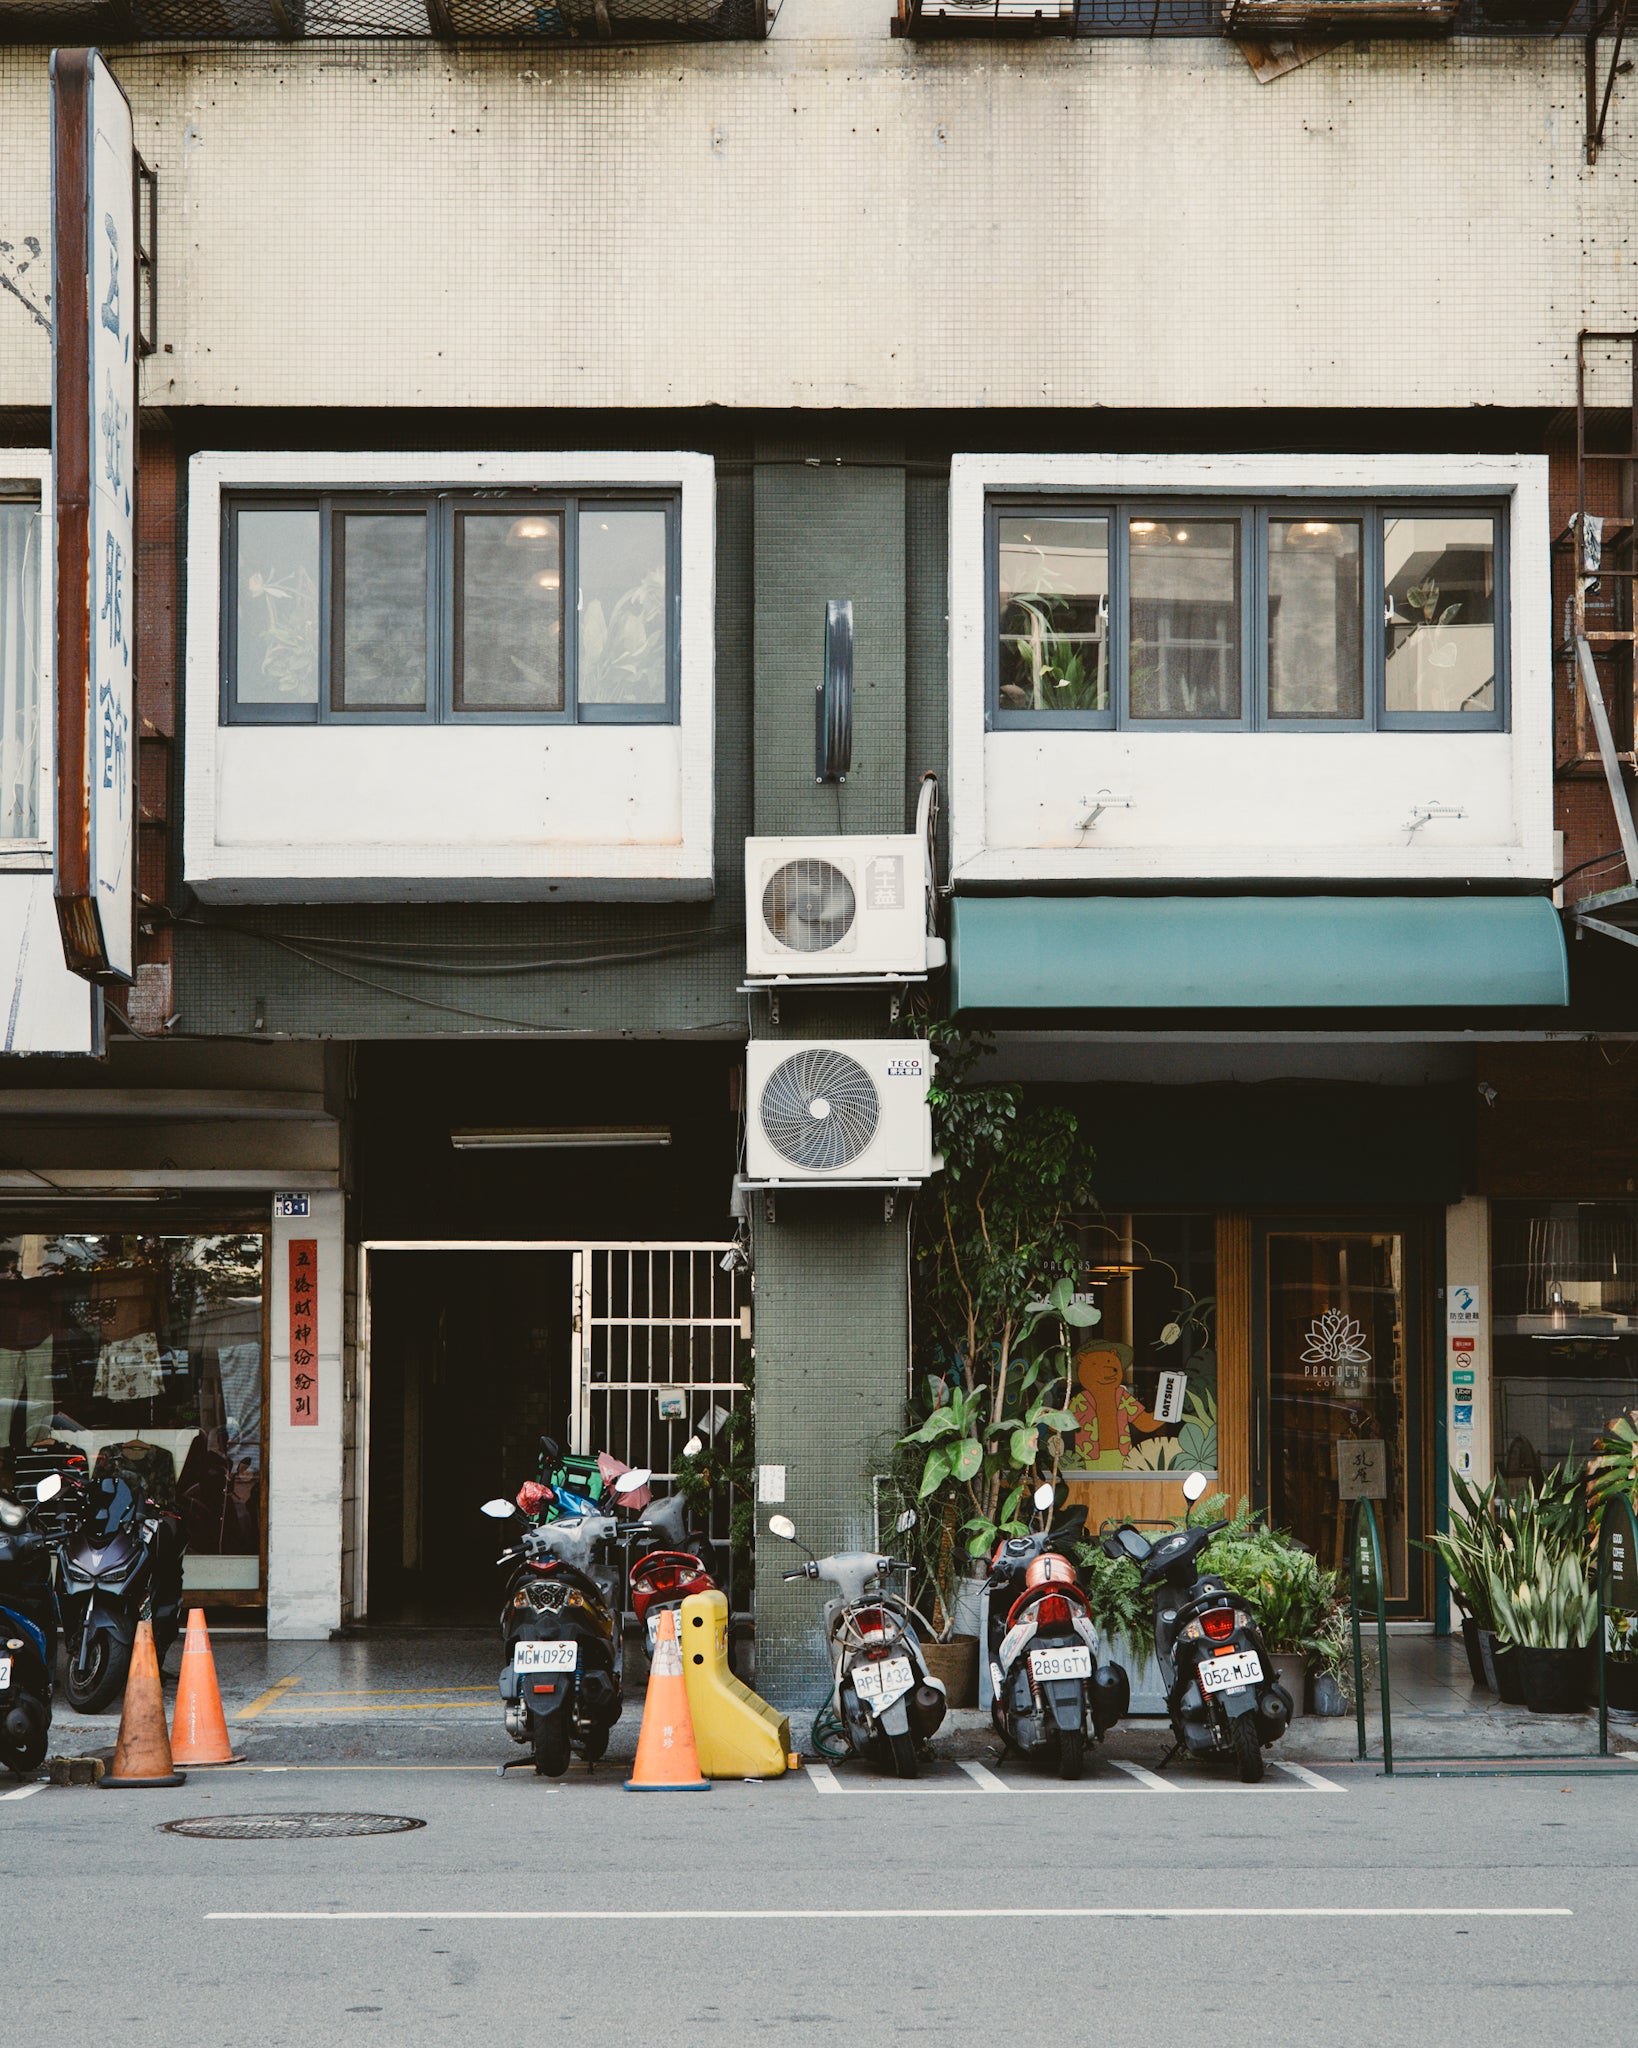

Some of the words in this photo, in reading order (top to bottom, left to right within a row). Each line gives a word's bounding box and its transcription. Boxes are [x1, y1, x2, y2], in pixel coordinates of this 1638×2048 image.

[891, 1060, 919, 1068] TECO
[1304, 1365, 1368, 1378] PEACOCKS
[1161, 1377, 1175, 1418] OATSIDE
